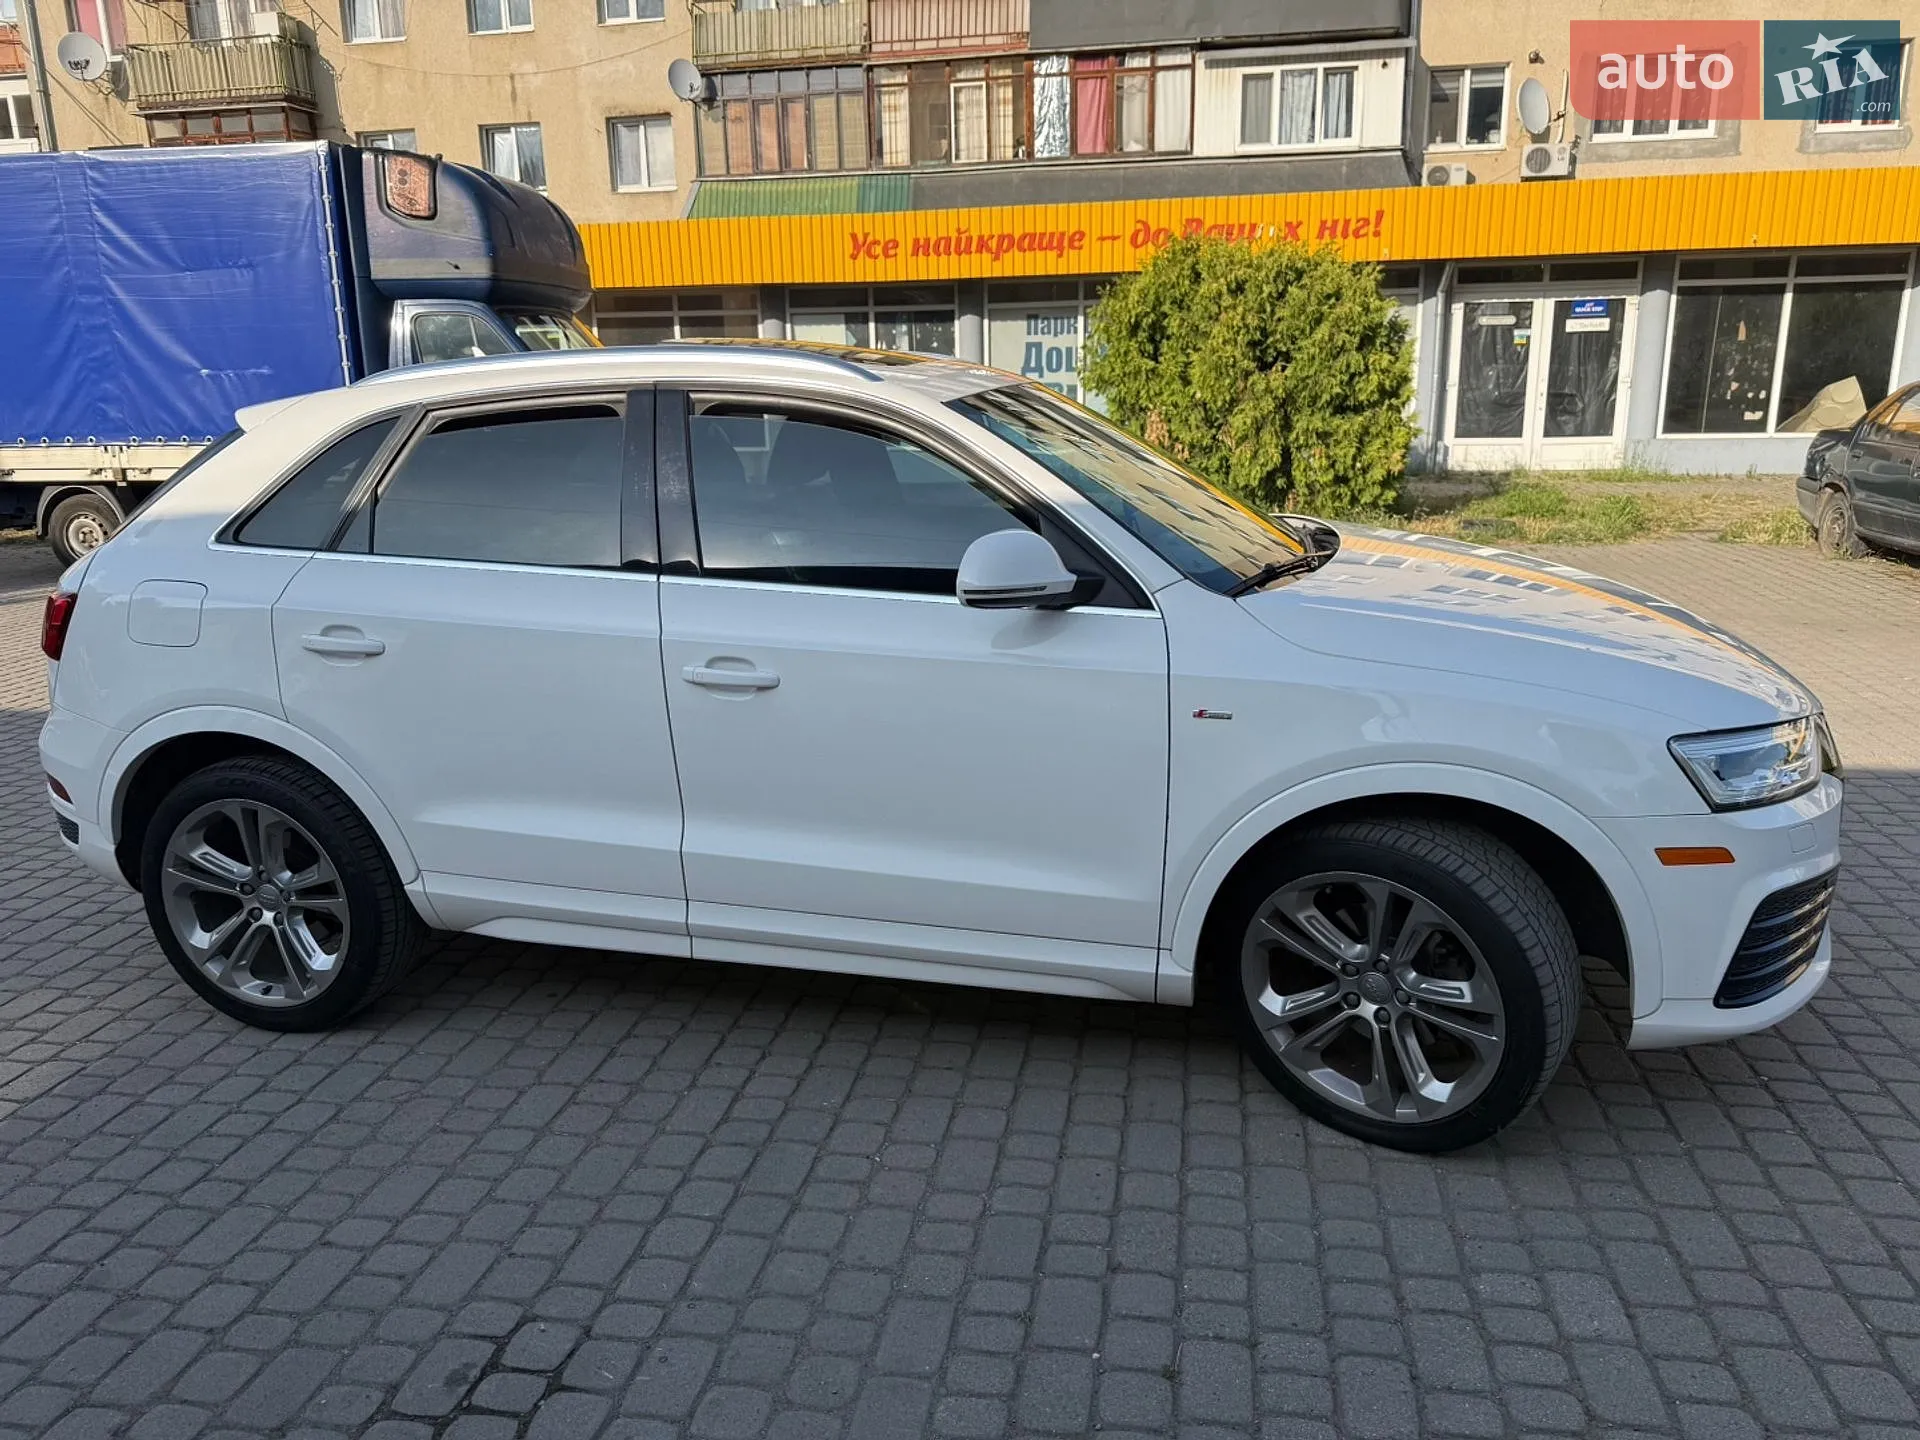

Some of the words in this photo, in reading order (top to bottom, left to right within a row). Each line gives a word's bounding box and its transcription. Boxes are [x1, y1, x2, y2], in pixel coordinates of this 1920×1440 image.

[849, 231, 900, 261] Усе
[910, 227, 1087, 263] найкраще
[1130, 219, 1171, 250] до
[1315, 209, 1385, 240] ніг!
[1026, 313, 1079, 338] Парк
